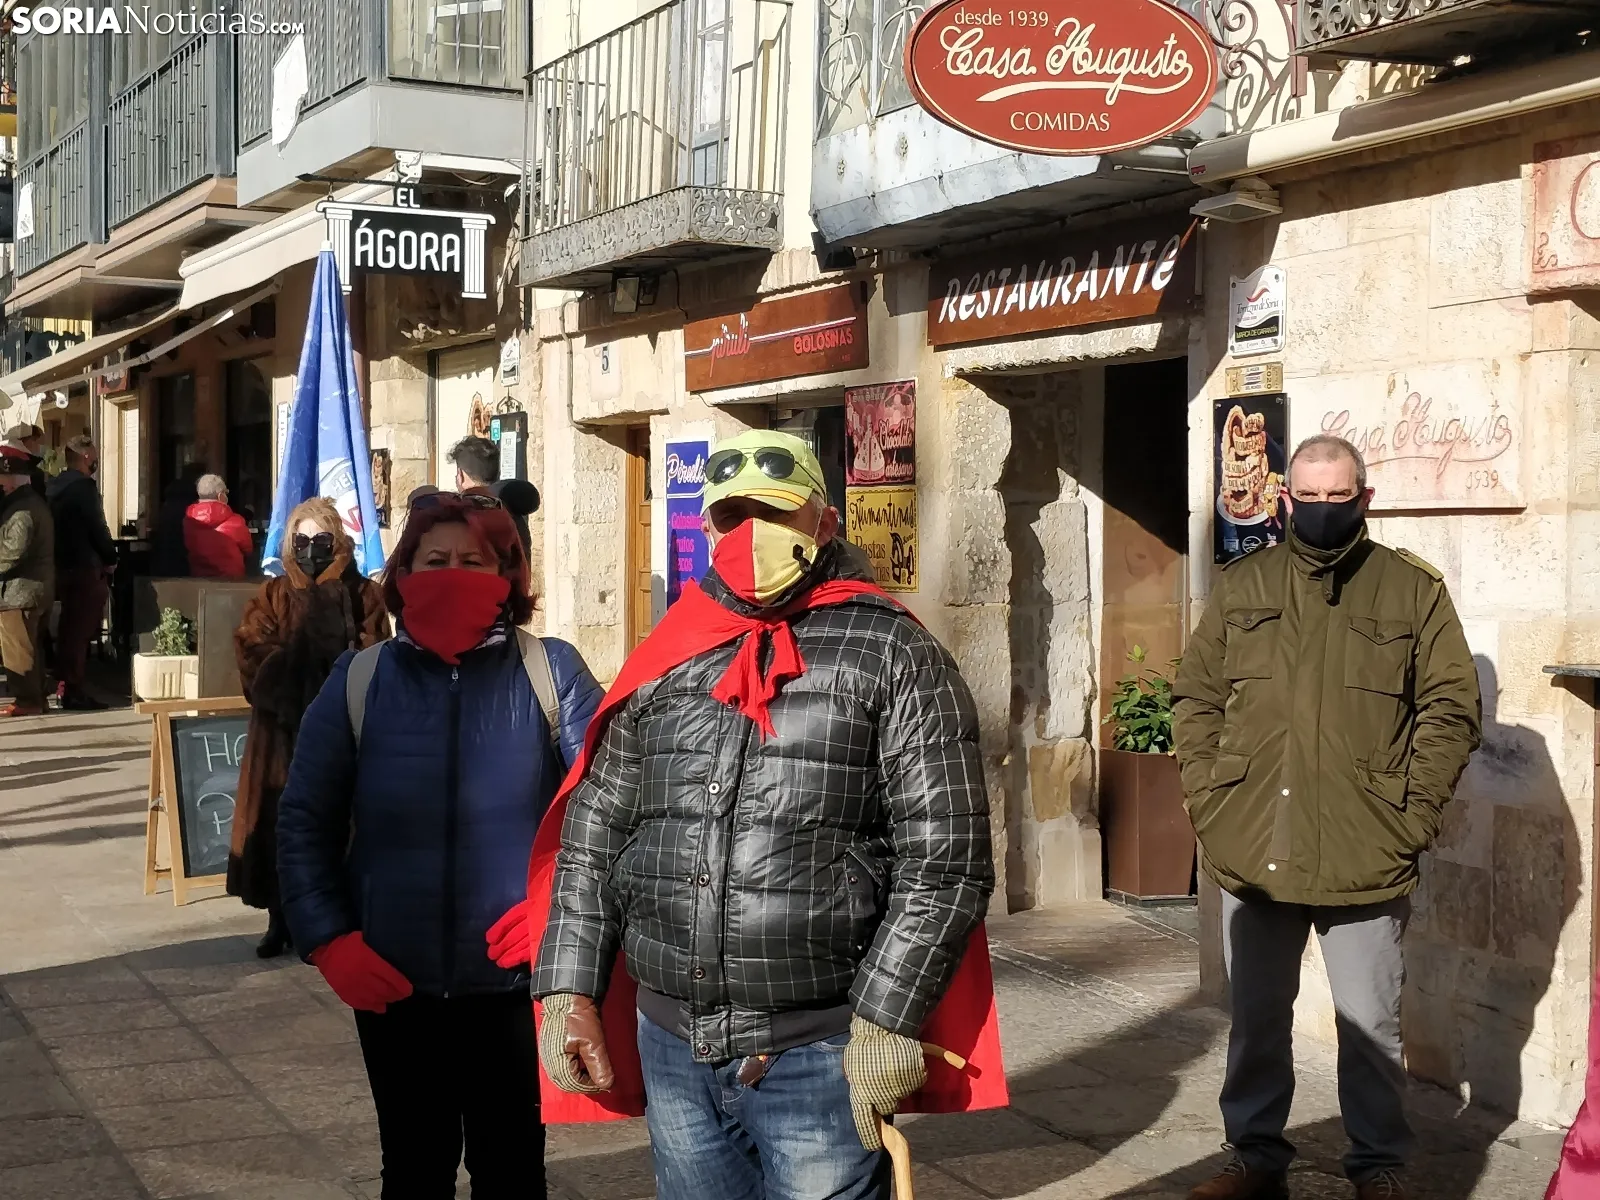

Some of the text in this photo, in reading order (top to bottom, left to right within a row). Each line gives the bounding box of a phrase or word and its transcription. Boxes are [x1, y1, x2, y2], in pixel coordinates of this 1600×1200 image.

[954, 8, 1049, 27] desde 1939
[940, 17, 1193, 105] Casa Augusto
[1010, 111, 1110, 132] COMIDAS
[396, 188, 420, 208] EL
[354, 218, 460, 273] ÁGORA
[938, 235, 1181, 324] RESTAURANTE
[794, 329, 854, 354] GOLOSINAS
[602, 346, 609, 371] 5
[879, 418, 913, 450] Chocolate
[1393, 392, 1512, 479] Augusto
[1465, 470, 1499, 489] 1939
[671, 511, 701, 530] Golosina
